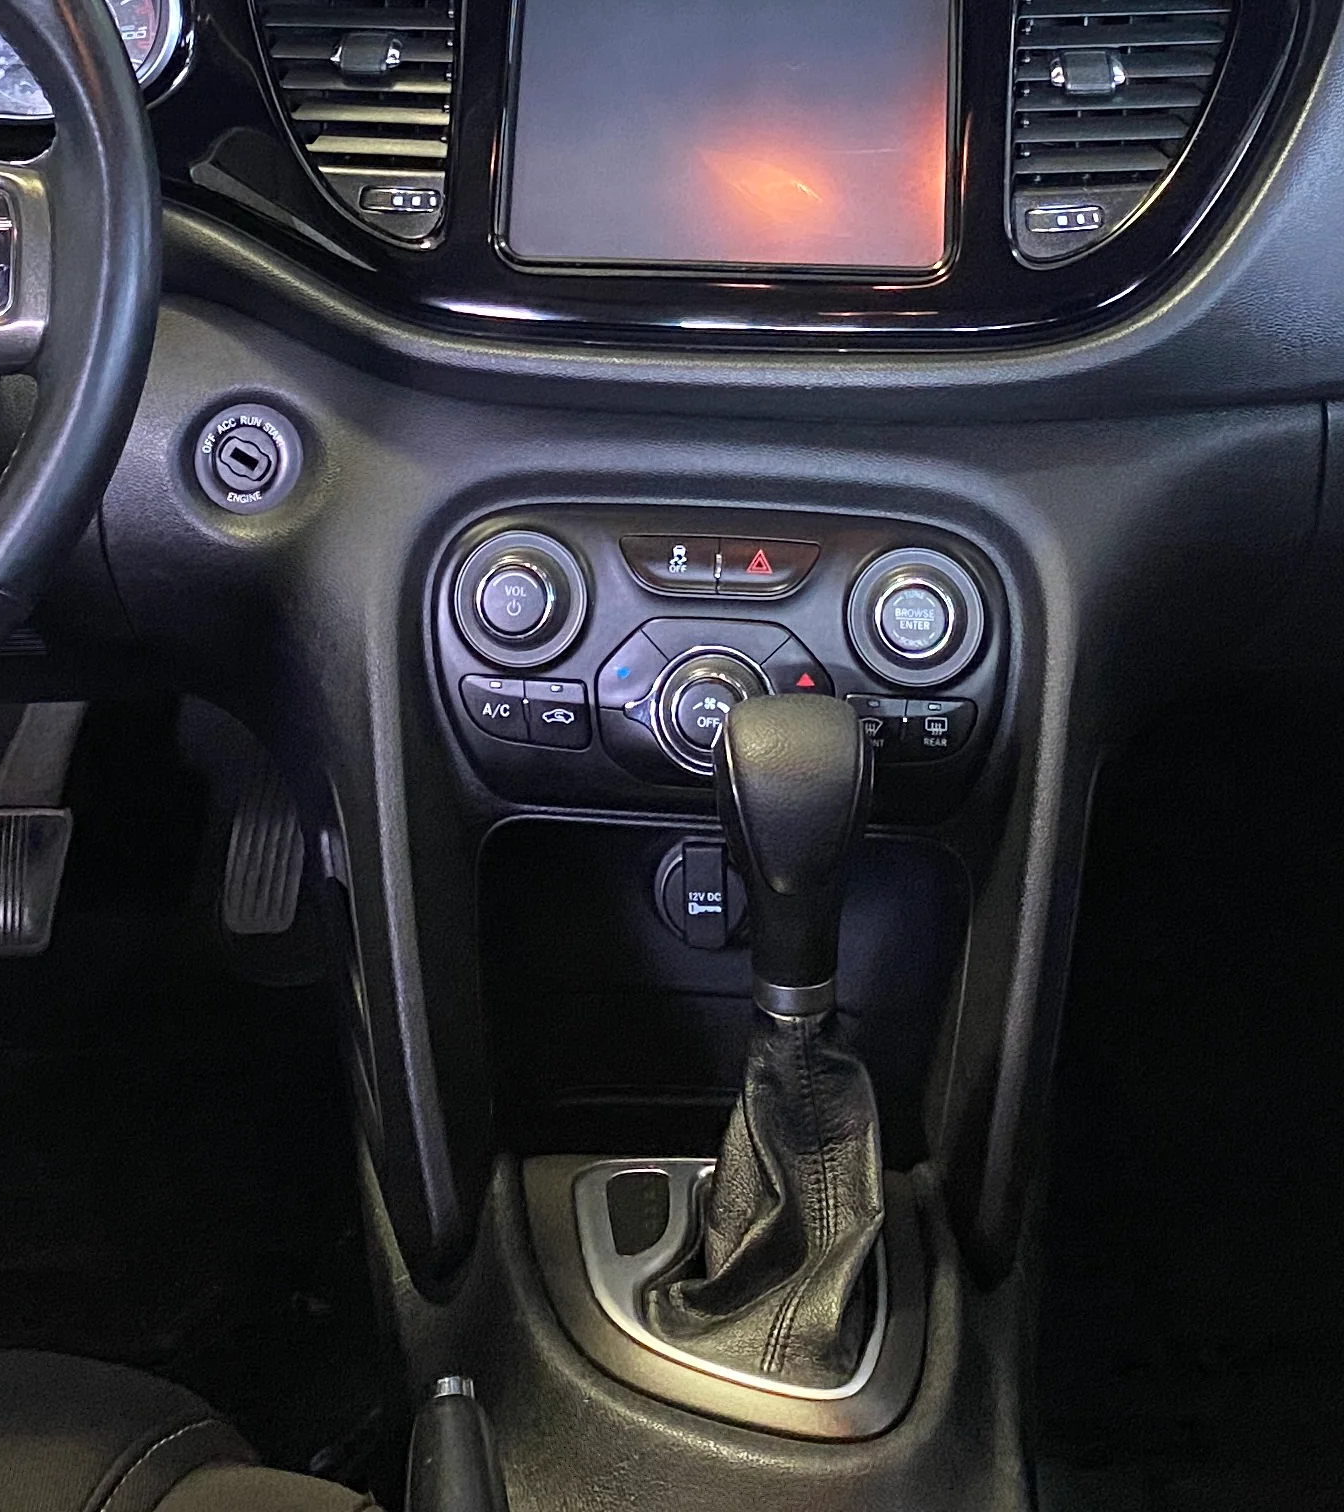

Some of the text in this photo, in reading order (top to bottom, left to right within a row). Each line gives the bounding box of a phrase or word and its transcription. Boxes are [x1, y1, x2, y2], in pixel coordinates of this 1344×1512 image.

[201, 415, 286, 454] OFF ACC RUN START
[226, 491, 262, 504] ENGINE
[669, 564, 687, 574] OFF
[505, 584, 527, 597] VOL
[894, 607, 935, 619] BROWSE
[899, 620, 931, 631] ENTER
[482, 702, 511, 719] A/C
[696, 716, 721, 729] OFF
[923, 737, 948, 747] REAR
[688, 891, 722, 902] 12V DC
